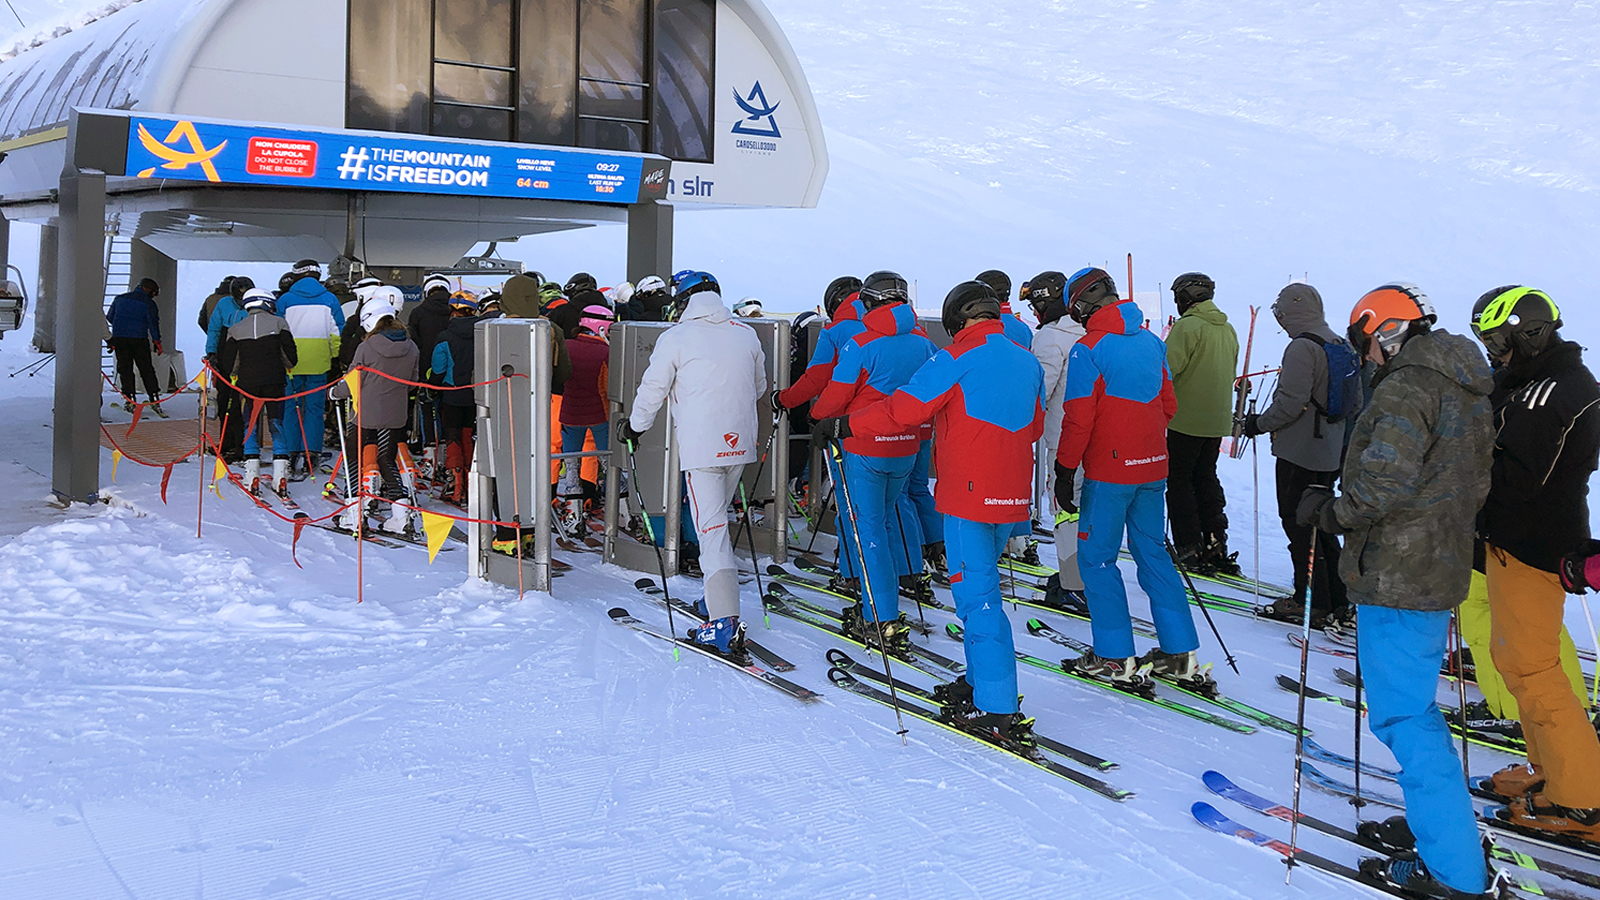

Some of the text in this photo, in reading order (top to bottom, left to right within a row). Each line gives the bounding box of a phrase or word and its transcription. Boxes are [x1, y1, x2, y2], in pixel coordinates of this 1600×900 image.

[274, 142, 311, 150] CHIUDERE
[273, 150, 304, 158] CUPOLA
[284, 158, 308, 166] CLOSE
[596, 162, 620, 172] 09:27
[367, 164, 488, 187] ISFREEDOM
[517, 178, 549, 188] 64 cm
